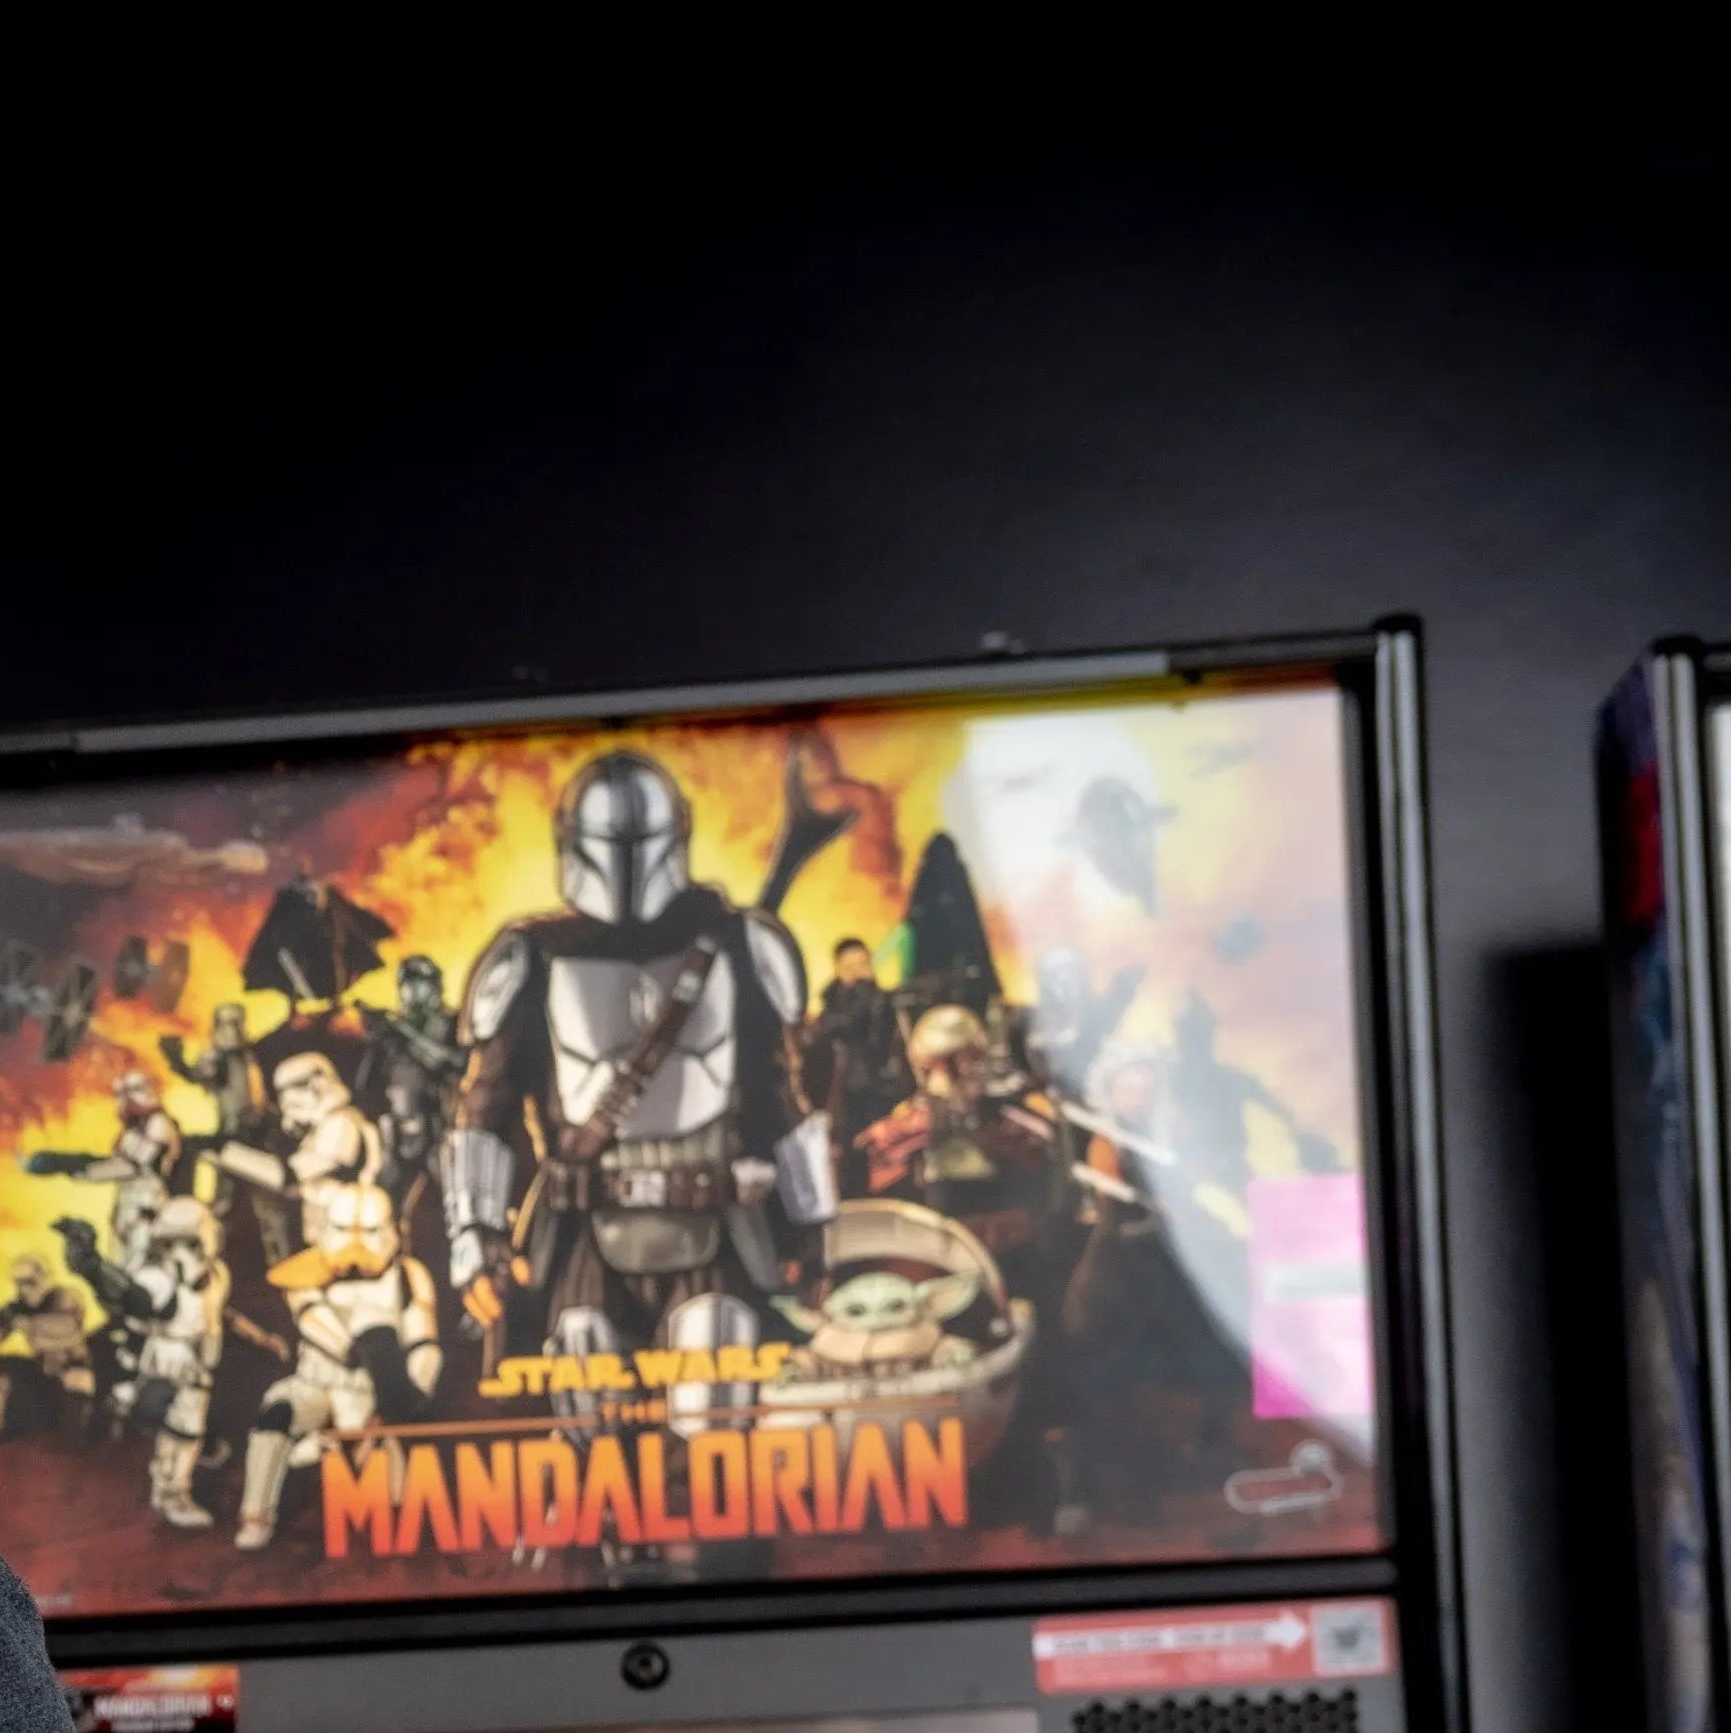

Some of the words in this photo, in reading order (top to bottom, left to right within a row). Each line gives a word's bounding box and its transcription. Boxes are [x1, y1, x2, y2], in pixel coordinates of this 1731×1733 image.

[478, 1353, 631, 1397] STAR
[633, 1342, 791, 1385] WARS
[599, 1401, 668, 1422] THE
[321, 1417, 968, 1558] MANDALORIAN
